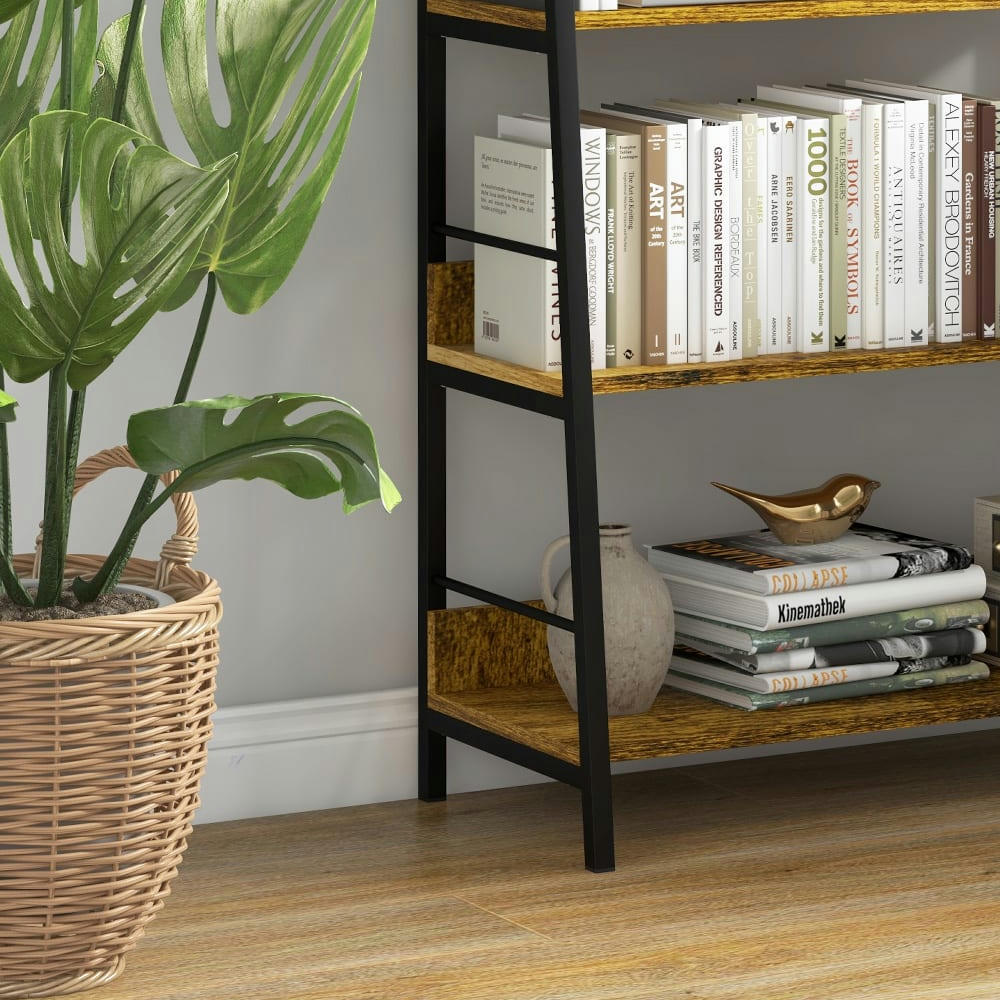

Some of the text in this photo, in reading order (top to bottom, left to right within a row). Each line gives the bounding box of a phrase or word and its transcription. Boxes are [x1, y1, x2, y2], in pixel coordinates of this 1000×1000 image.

[585, 137, 600, 235] WINDOWS
[807, 127, 827, 196] 1000
[848, 160, 858, 208] BOOK
[650, 183, 664, 220] ART
[671, 181, 684, 218] ART
[892, 167, 903, 285] ANTIQUAIRES
[945, 102, 959, 326] ALEXEY BRODOVITCH
[964, 173, 974, 275] Gardens in France
[693, 249, 701, 263] BOOK
[714, 146, 723, 317] GRAPHIC DESIGN REFERENCED
[731, 217, 740, 278] BORDEAUX
[848, 228, 858, 314] SYMBOLS
[772, 566, 848, 594] COLLAPSE
[777, 595, 846, 623] Kinemathek
[772, 668, 848, 693] COLLAPSE
